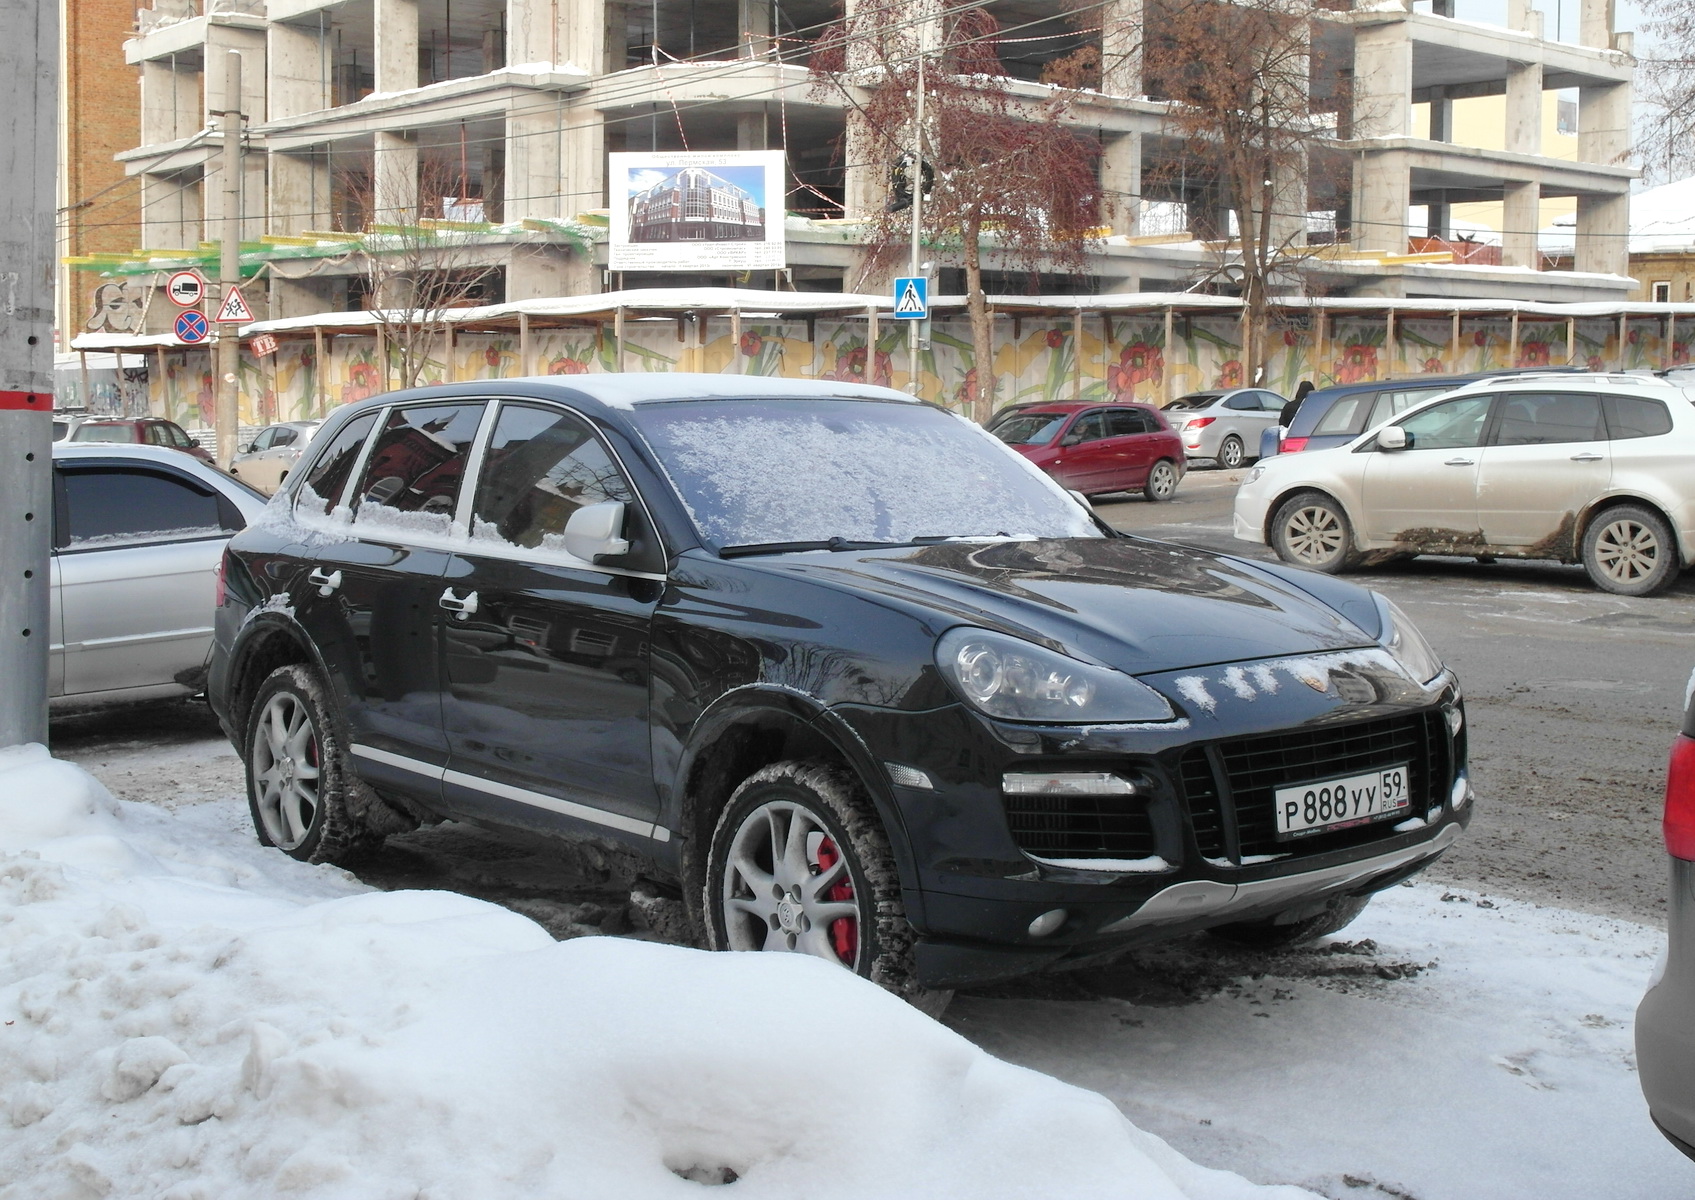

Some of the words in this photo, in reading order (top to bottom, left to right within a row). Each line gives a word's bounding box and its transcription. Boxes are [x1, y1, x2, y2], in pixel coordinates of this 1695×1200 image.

[253, 336, 276, 352] ТВ
[1383, 771, 1402, 799] 59
[1382, 800, 1397, 810] RUS
